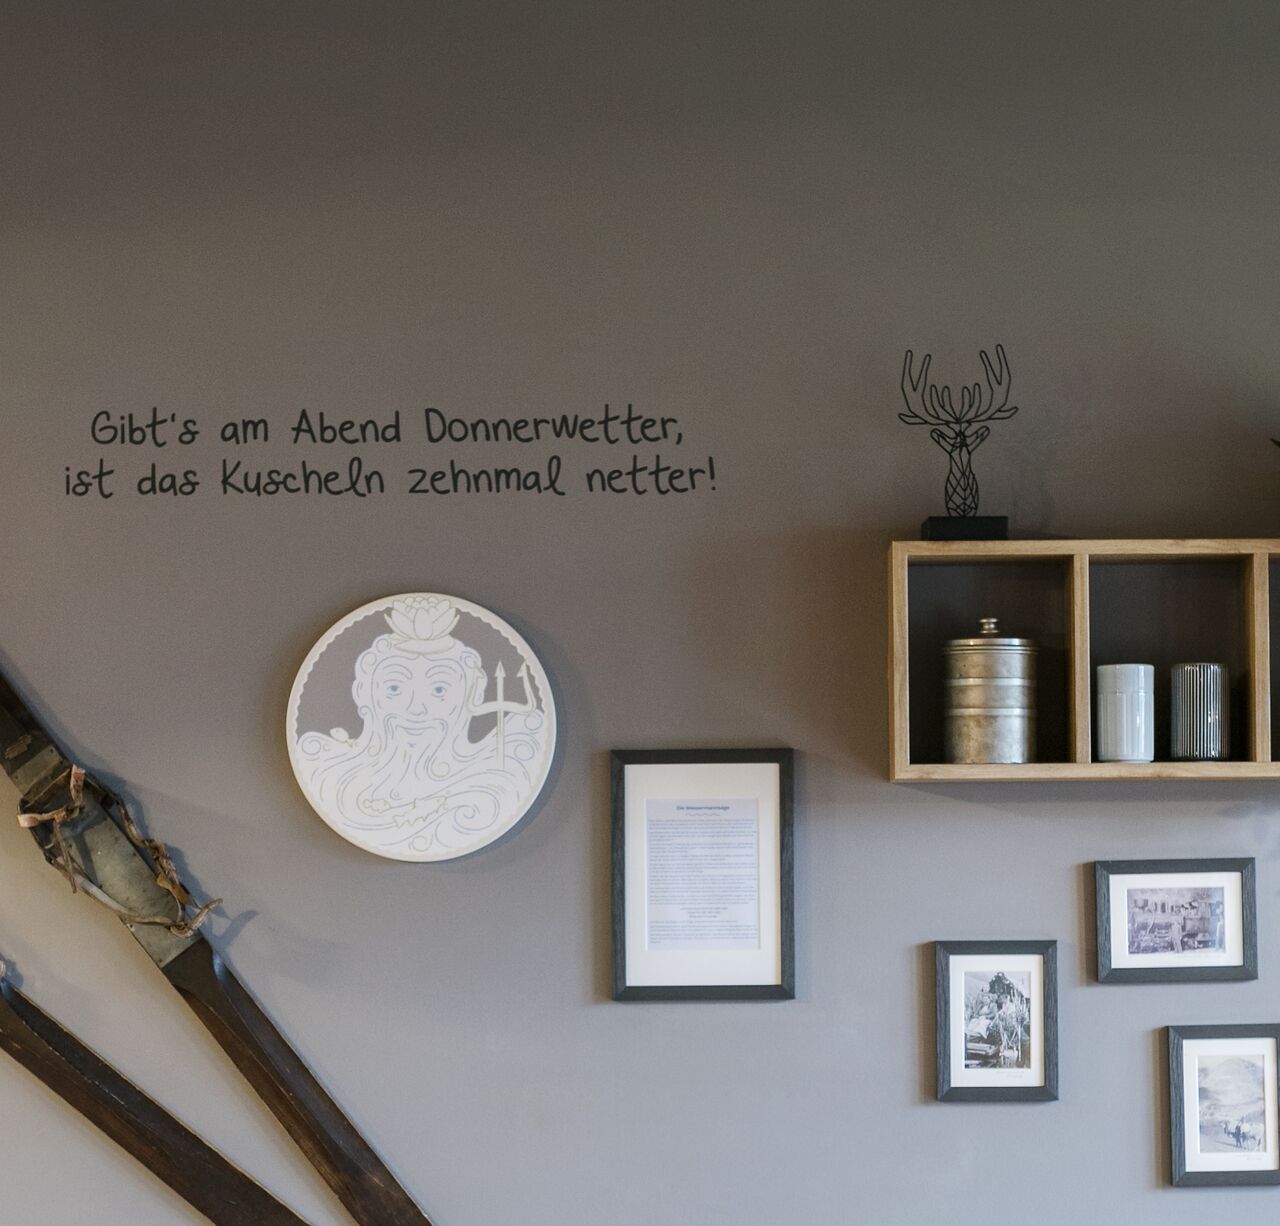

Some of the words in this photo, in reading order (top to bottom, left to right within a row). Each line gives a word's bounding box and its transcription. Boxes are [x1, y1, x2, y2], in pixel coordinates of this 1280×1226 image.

[91, 408, 200, 447] Gibt's
[220, 418, 268, 445] am
[291, 408, 402, 445] Abend
[424, 404, 683, 446] Donnerwetter,
[65, 458, 115, 499] ist
[137, 463, 201, 497] das
[221, 457, 385, 498] Kuscheln
[407, 455, 566, 497] zehnmal
[586, 454, 718, 496] netter!
